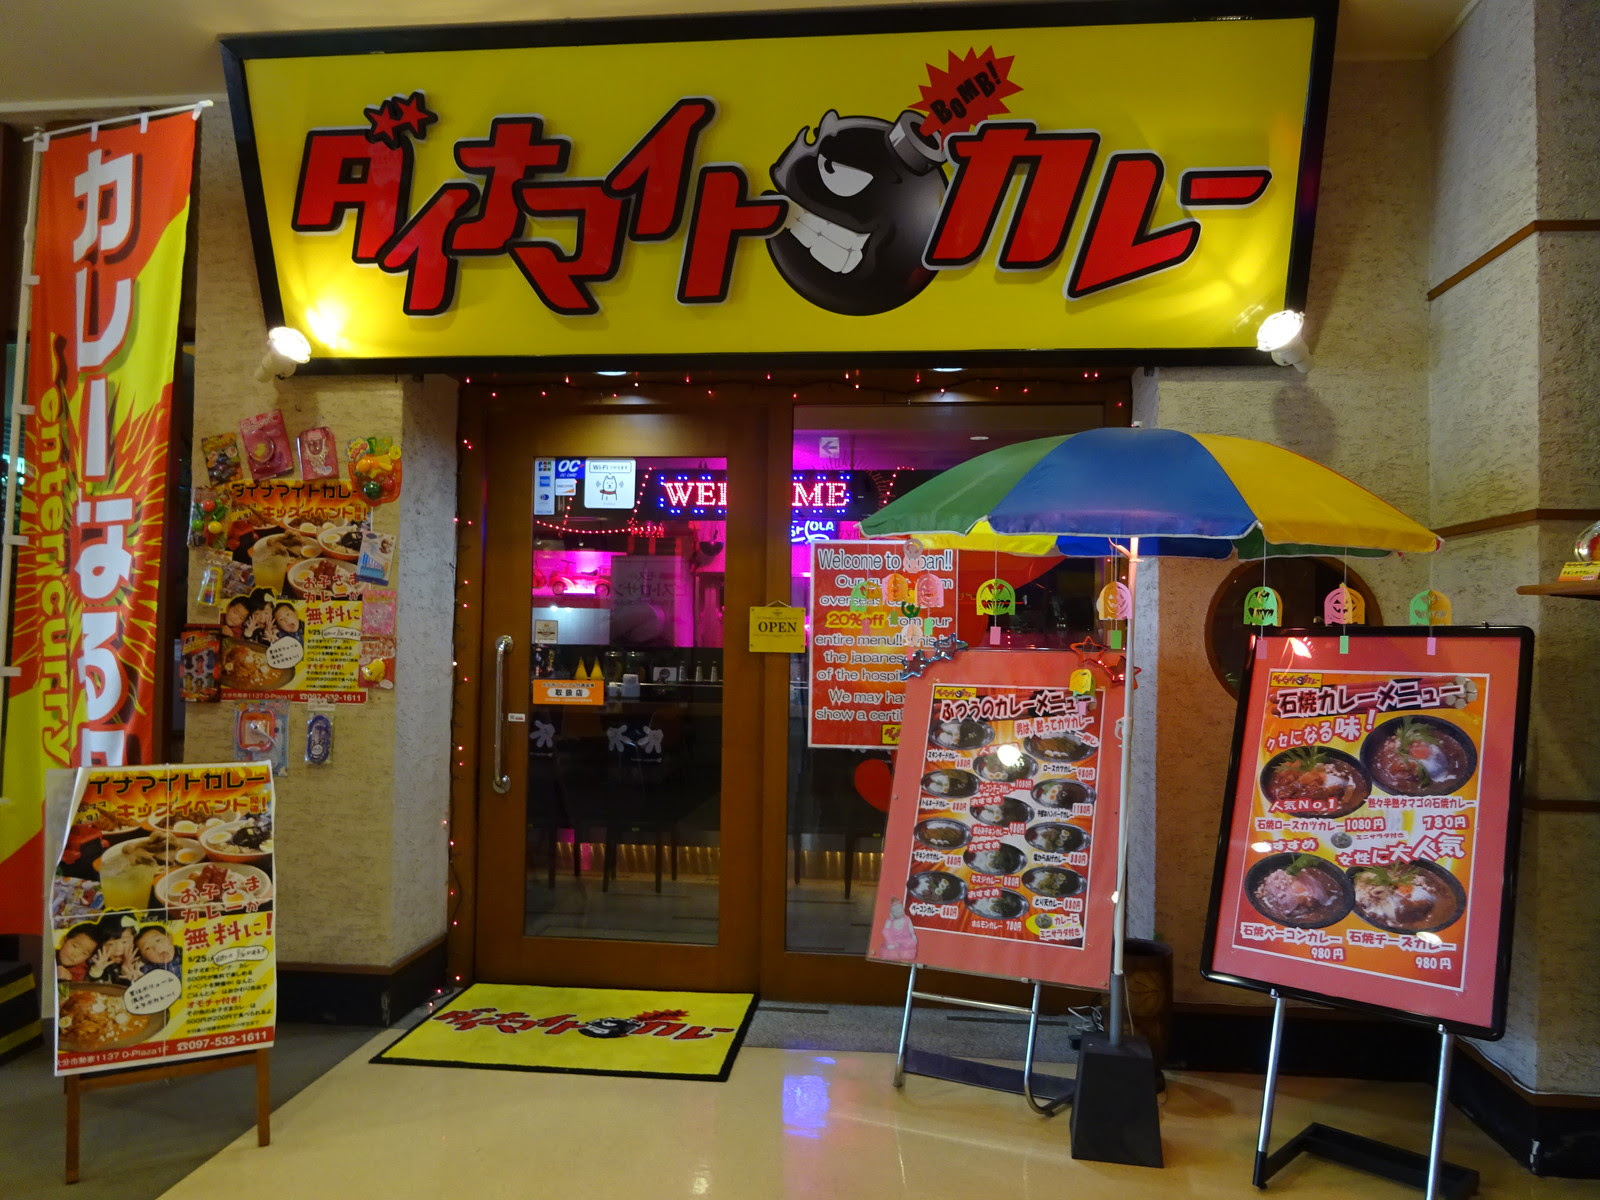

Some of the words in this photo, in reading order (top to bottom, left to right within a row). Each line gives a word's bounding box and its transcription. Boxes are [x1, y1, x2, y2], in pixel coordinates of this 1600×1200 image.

[930, 60, 1003, 127] BOMB!
[290, 92, 789, 316] ダイナマイト
[924, 119, 1272, 301] カレー
[558, 460, 581, 473] OC
[818, 549, 882, 570] Welcome
[885, 551, 901, 570] to
[904, 549, 953, 571] pan!!
[835, 575, 865, 588] Our
[757, 621, 798, 633] OPEN
[815, 633, 854, 646] entire
[857, 632, 903, 646] menu!!
[825, 650, 847, 663] the
[850, 650, 905, 664] japanes
[817, 668, 833, 680] of
[836, 668, 858, 680] the
[829, 690, 851, 703] We
[854, 692, 882, 705] may
[1277, 680, 1465, 719] 石焼カレーメニュー
[815, 708, 853, 720] show
[856, 711, 866, 720] a
[1266, 708, 1377, 752] クセになる味!
[1257, 818, 1346, 832] 石焼ロースカツカレー
[1345, 817, 1387, 832] 1080円
[1422, 814, 1468, 831] 780円
[1335, 832, 1468, 868] 女性に大人気
[181, 876, 261, 905] お子さま
[183, 912, 273, 952] 無料に!
[1241, 924, 1344, 945] 石焼ベーコンカレー
[1311, 946, 1345, 961] 980円
[1415, 956, 1452, 970] 980円
[188, 1031, 267, 1051] 097-532-1611
